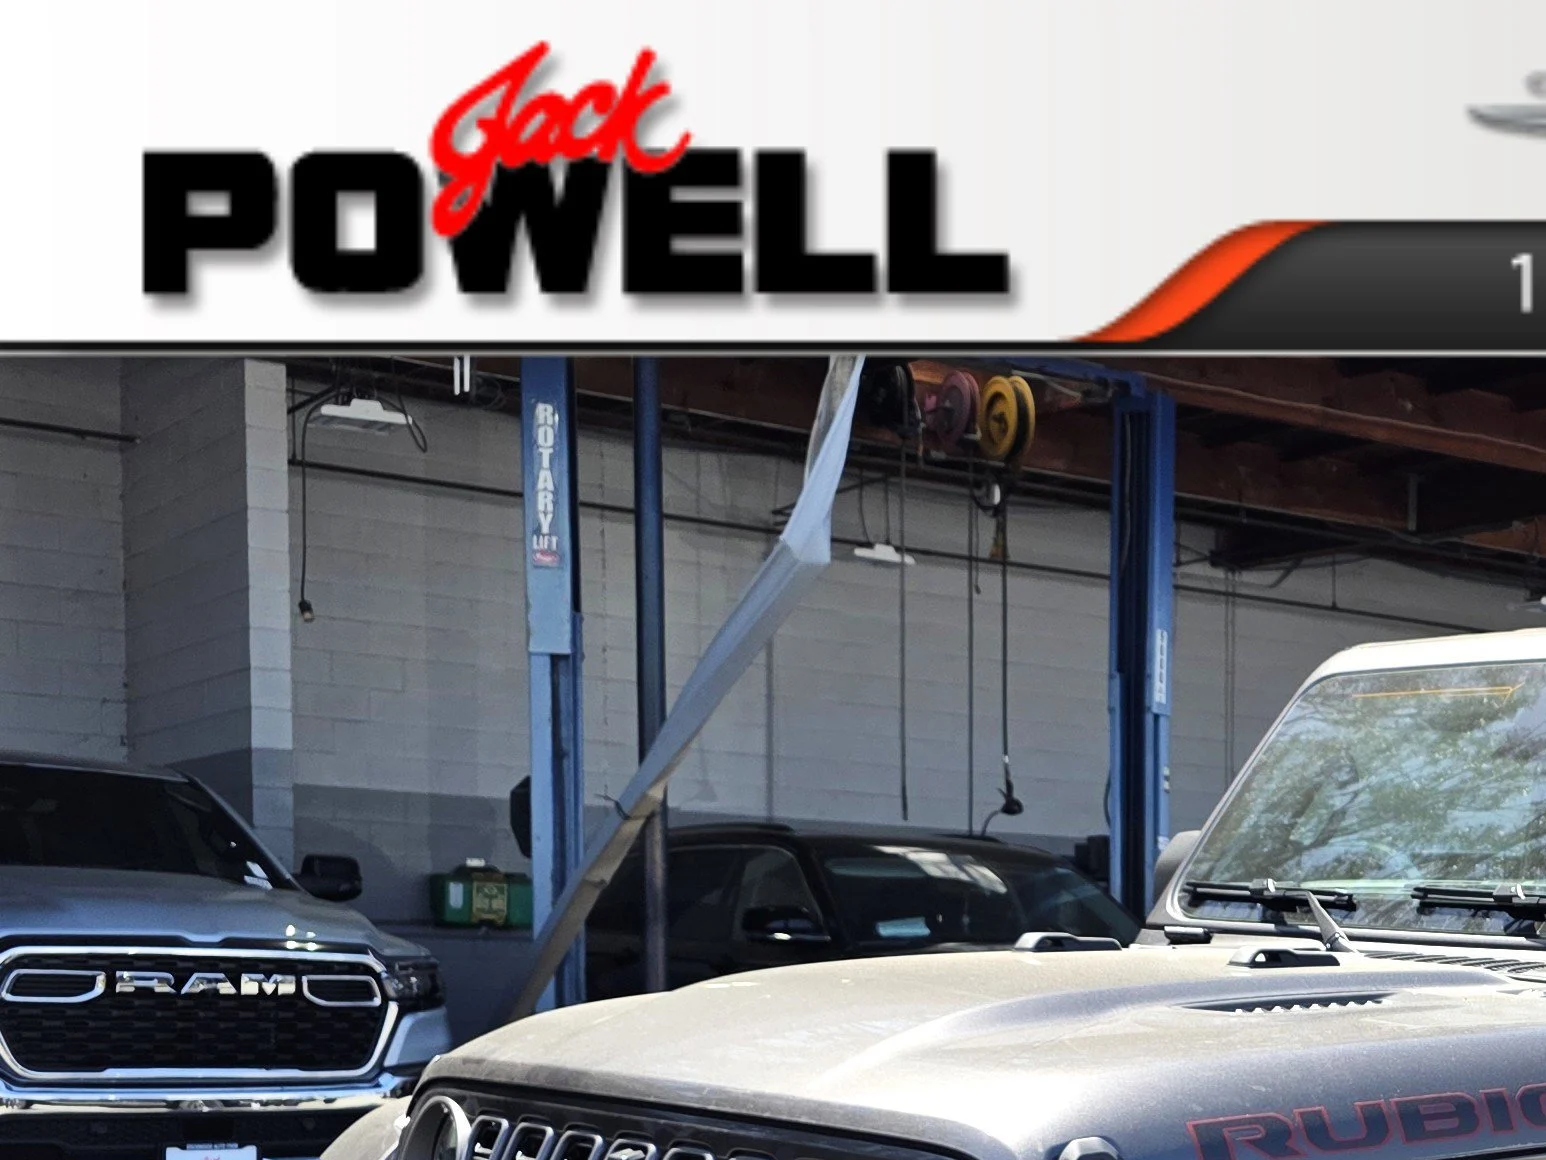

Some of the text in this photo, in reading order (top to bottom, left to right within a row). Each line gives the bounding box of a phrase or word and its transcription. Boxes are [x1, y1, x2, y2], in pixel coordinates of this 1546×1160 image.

[535, 402, 555, 535] ROTARY
[532, 535, 558, 551] LIFT
[115, 970, 297, 995] RAM
